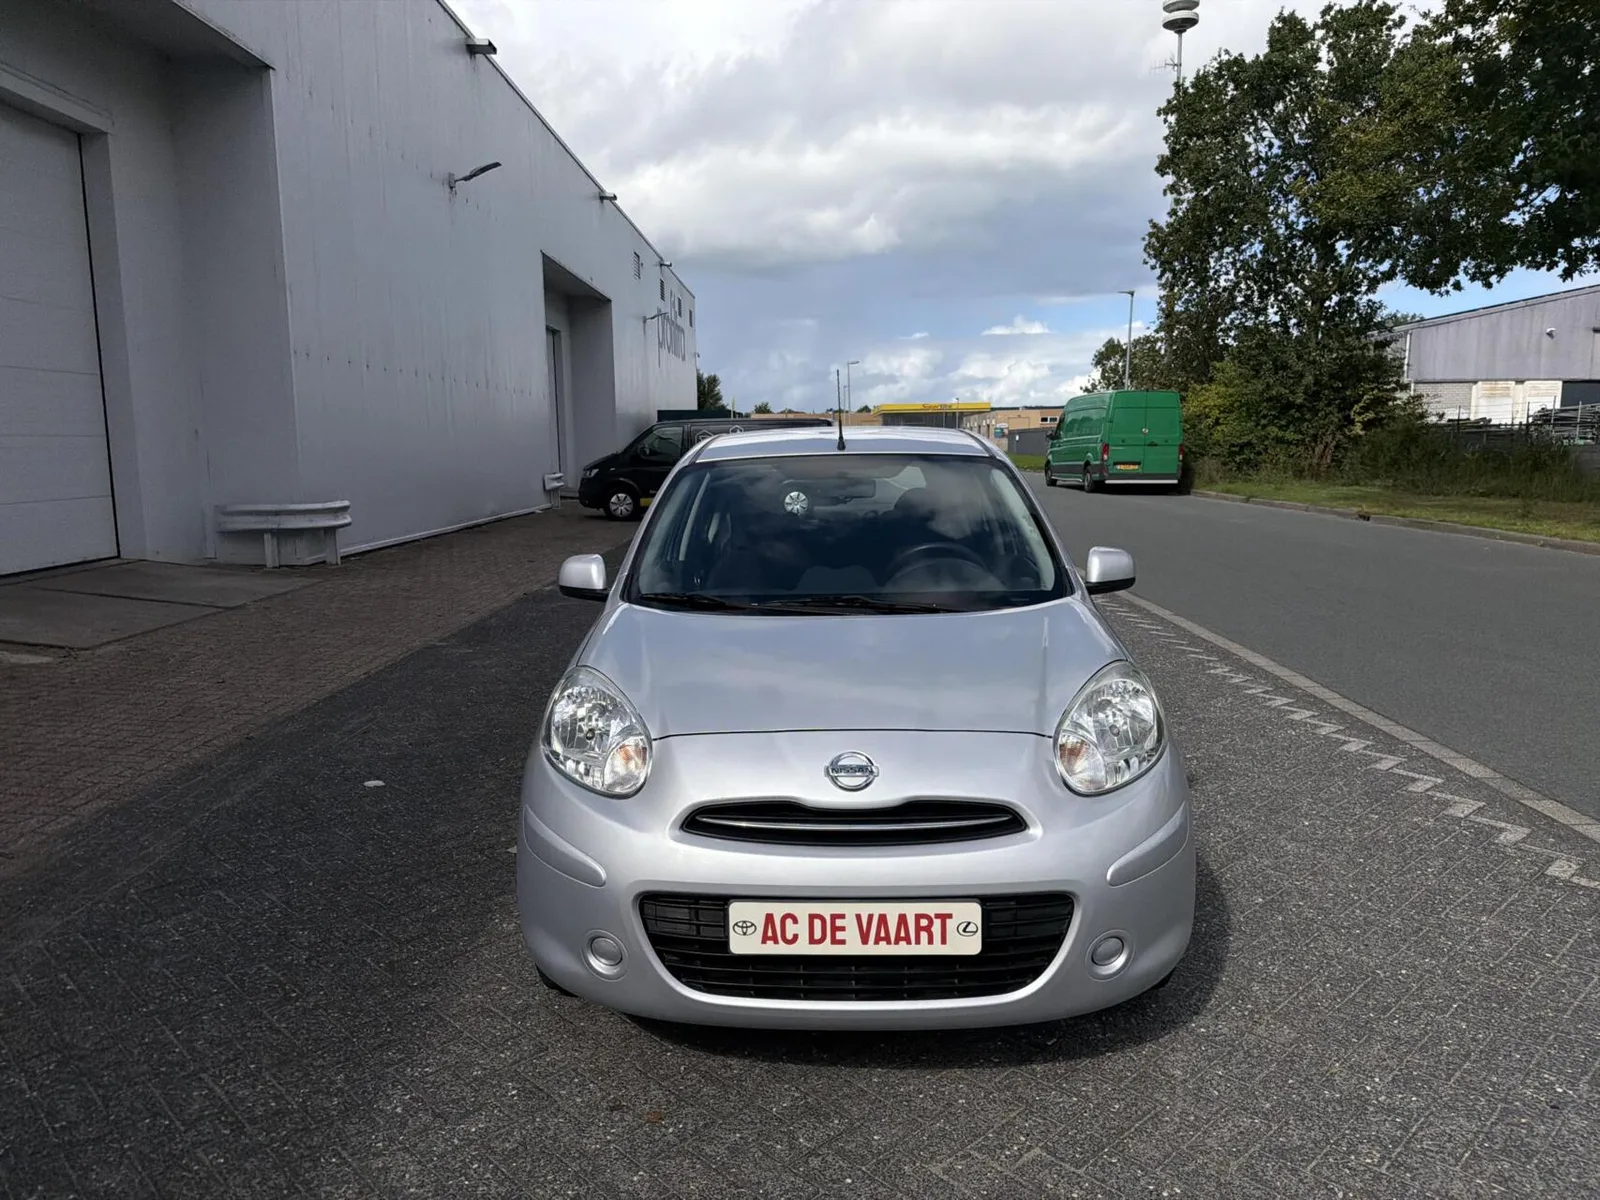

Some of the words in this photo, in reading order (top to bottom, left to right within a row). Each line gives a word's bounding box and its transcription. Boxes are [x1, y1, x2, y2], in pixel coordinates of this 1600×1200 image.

[760, 912, 799, 946] AC
[808, 912, 847, 946] DE
[855, 912, 953, 946] VAART
